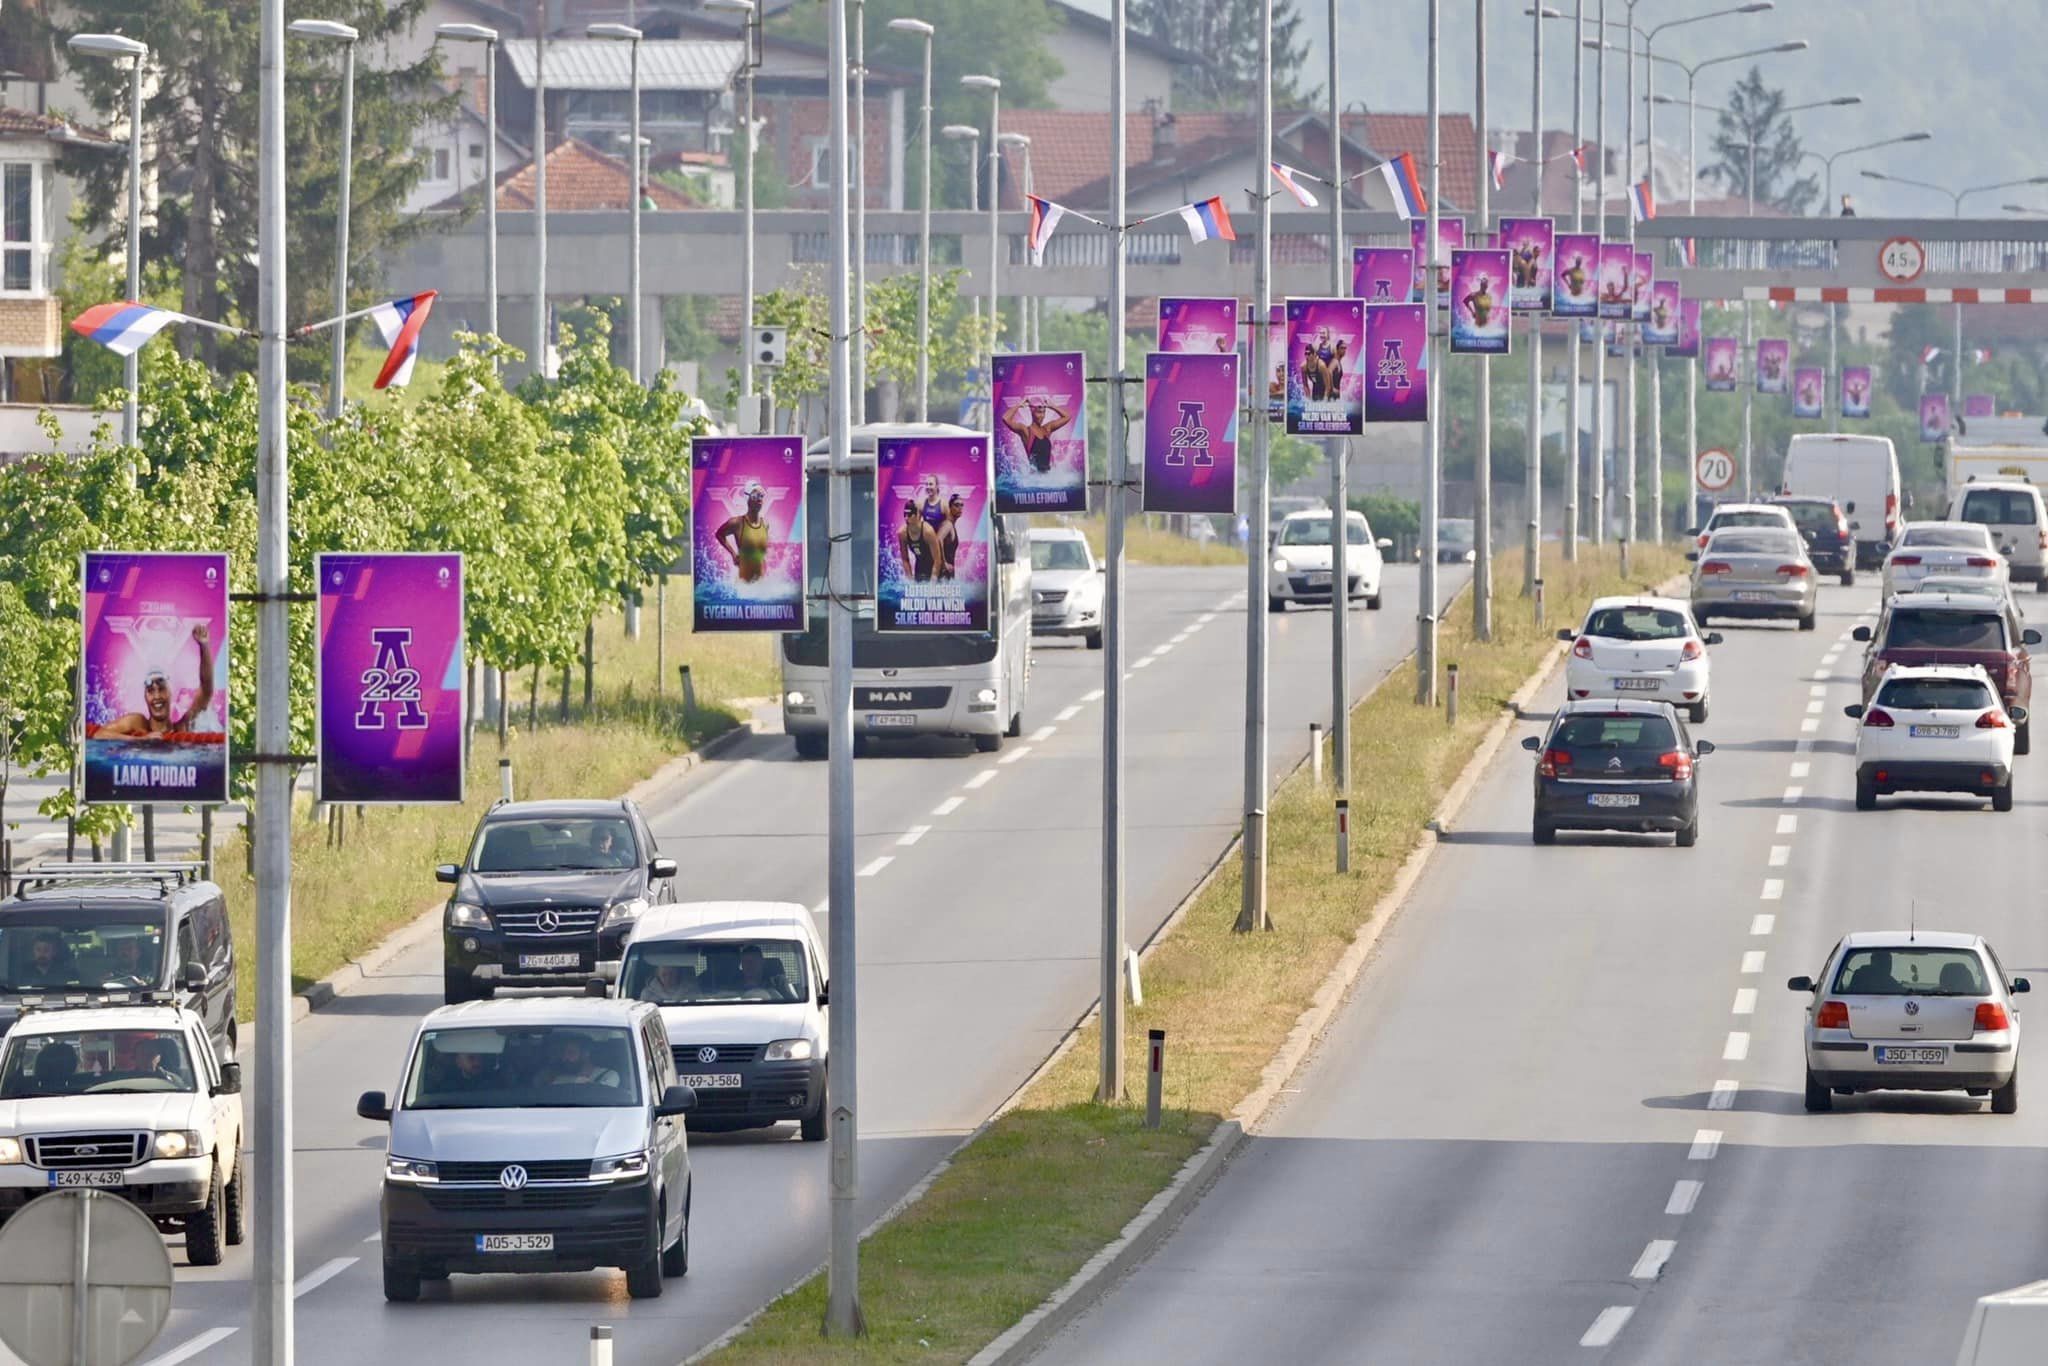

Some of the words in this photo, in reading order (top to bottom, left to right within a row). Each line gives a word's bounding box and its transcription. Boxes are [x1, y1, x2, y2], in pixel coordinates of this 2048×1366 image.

[1887, 252, 1907, 267] 4.5
[1170, 427, 1209, 448] 22
[1703, 459, 1727, 479] 70
[1013, 493, 1035, 504] YULIA
[1036, 491, 1068, 504] EFIMOVA
[745, 604, 794, 619] CHIKUNOVA
[900, 598, 925, 611] MILOU
[926, 598, 943, 611] VAN
[895, 612, 917, 625] SILKE
[918, 612, 972, 625] HOLKENBORG
[361, 668, 421, 701] 22
[869, 691, 912, 702] MAN
[113, 766, 149, 786] LANA
[150, 766, 197, 787] PUDAR
[683, 1075, 739, 1087] T69-J-586
[57, 1171, 122, 1185] E49-K-439
[485, 1236, 551, 1250] A05-J-529
